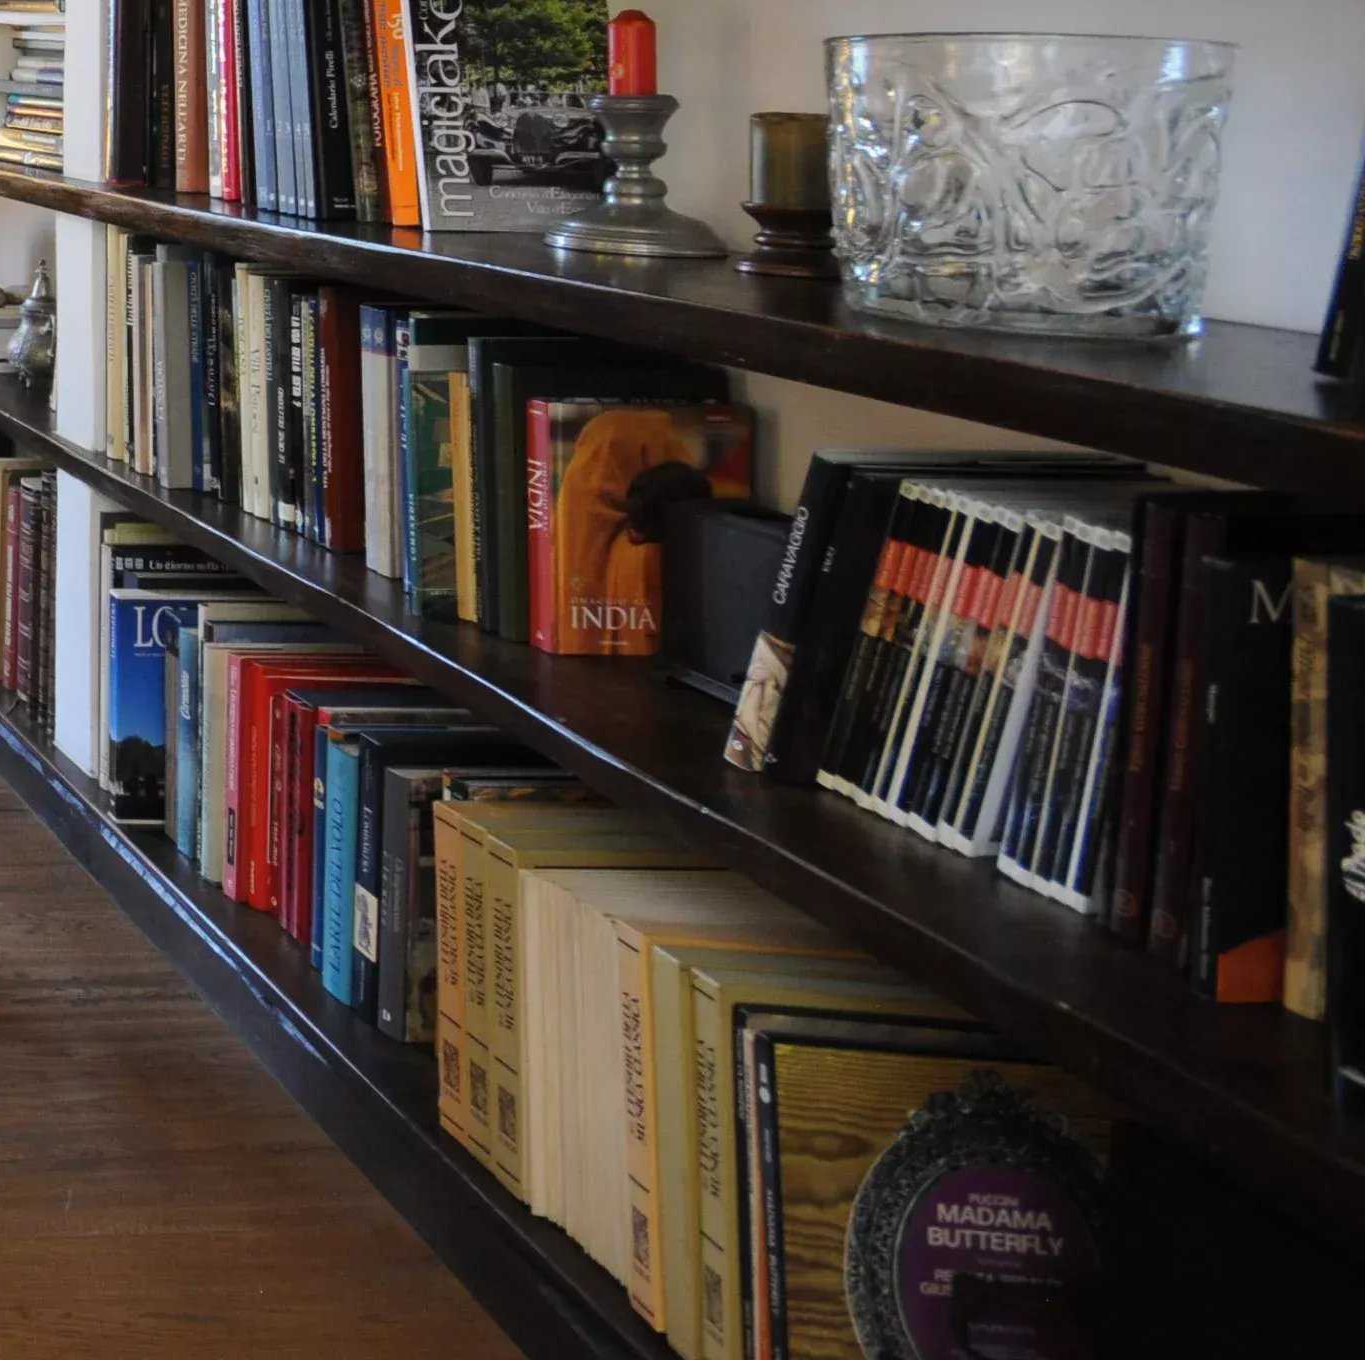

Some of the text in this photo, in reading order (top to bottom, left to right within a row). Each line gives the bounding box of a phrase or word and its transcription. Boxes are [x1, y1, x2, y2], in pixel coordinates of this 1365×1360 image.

[323, 50, 336, 78] Pirelli
[177, 79, 191, 161] NELL'ARTE
[325, 80, 339, 129] Calendario
[366, 73, 382, 147] FOTOGRAFIA
[527, 458, 545, 532] INDIA
[770, 504, 810, 607] CARAVAGGIO
[570, 605, 657, 631] INDIA
[327, 798, 343, 853] VOLO
[474, 882, 485, 951] CLASSICA
[503, 903, 514, 973] CLASSICA
[925, 1225, 1067, 1258] BUTTERFLY
[935, 1202, 1054, 1233] MADAMA
